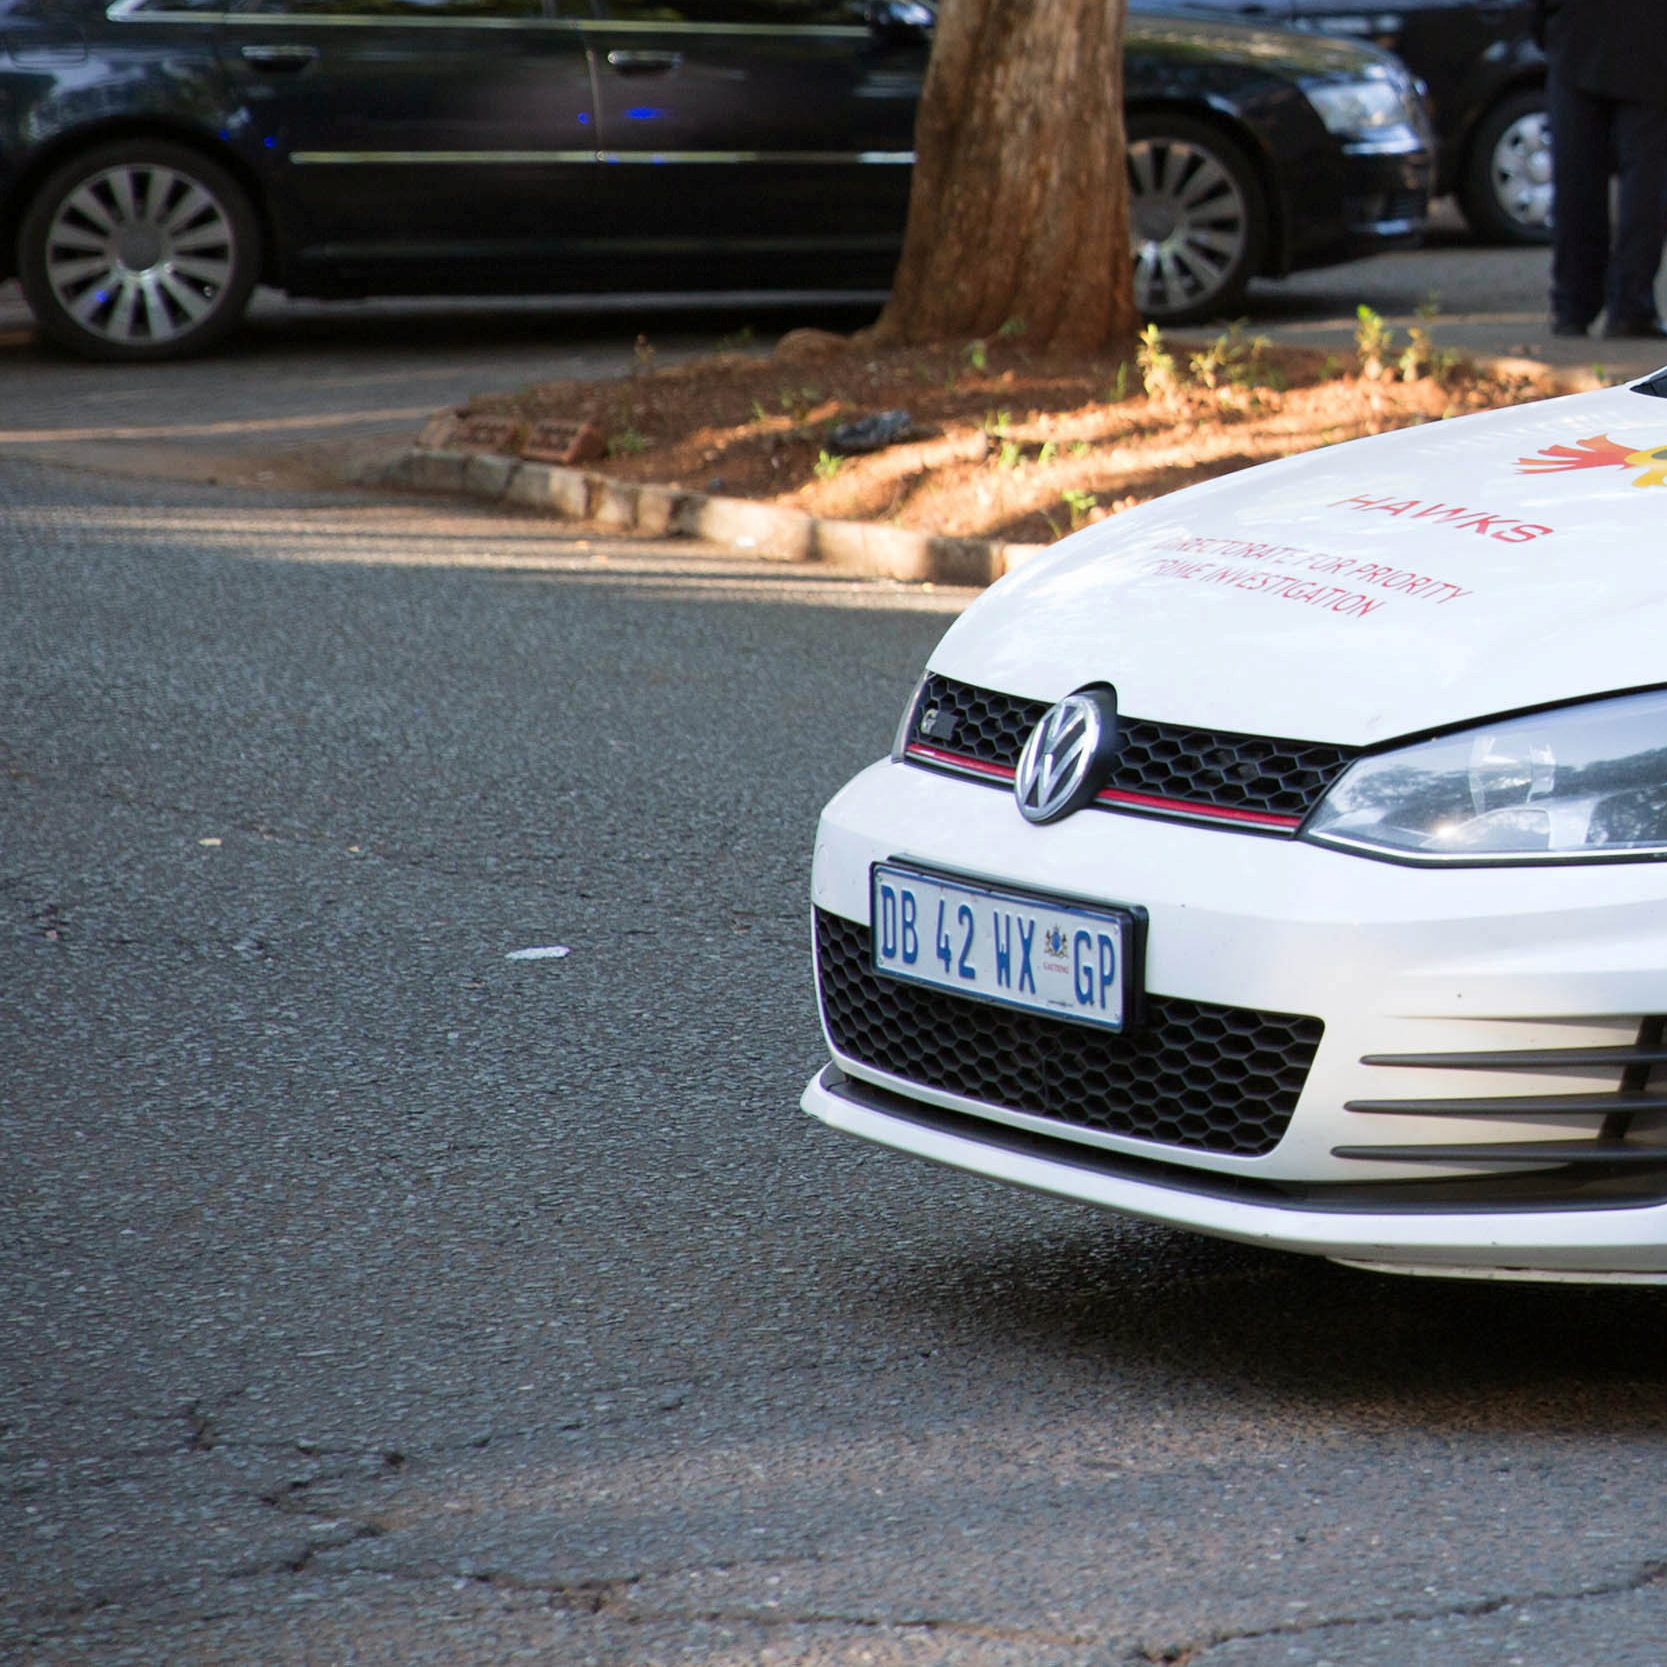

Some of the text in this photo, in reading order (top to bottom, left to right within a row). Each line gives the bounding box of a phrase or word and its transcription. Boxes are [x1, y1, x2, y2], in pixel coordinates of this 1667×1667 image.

[1328, 494, 1554, 544] HAWKS
[1199, 566, 1387, 618] INVESTIGATION
[1292, 552, 1358, 575] FOR
[1344, 563, 1474, 605] PRIORITY
[881, 884, 1116, 1010] DB 42 WX GP
